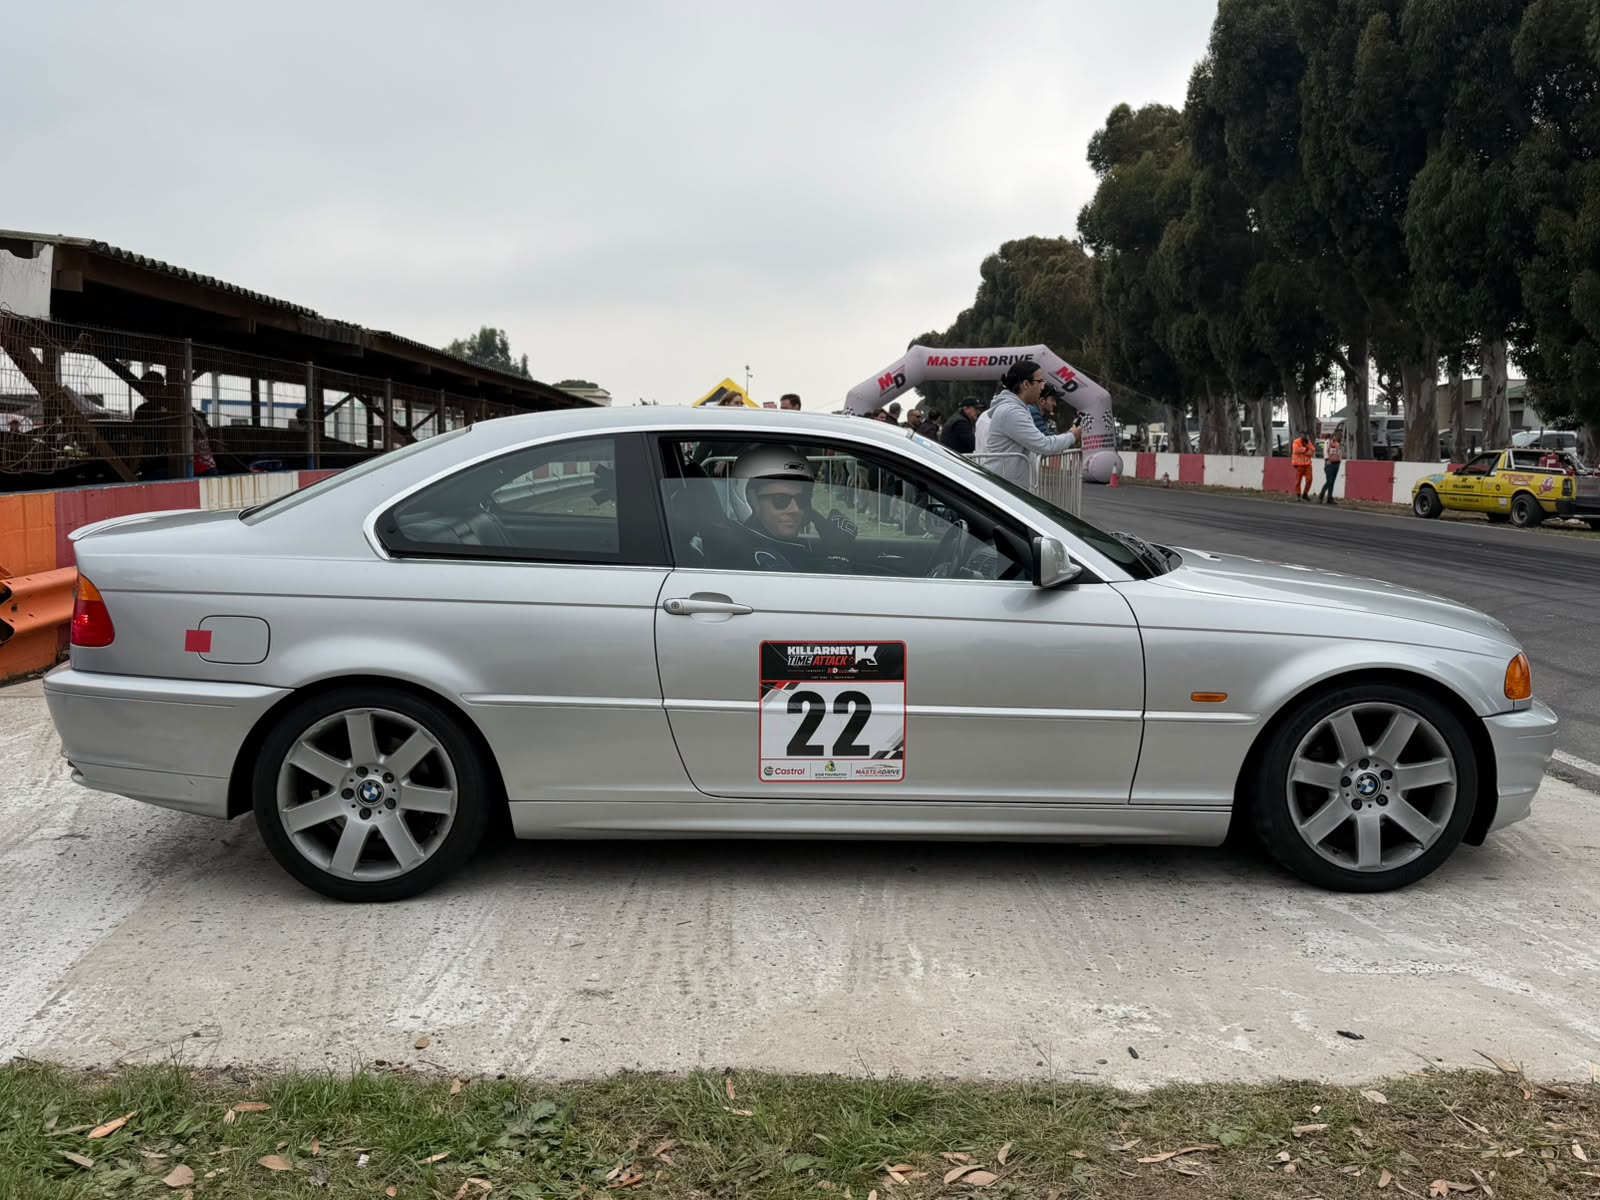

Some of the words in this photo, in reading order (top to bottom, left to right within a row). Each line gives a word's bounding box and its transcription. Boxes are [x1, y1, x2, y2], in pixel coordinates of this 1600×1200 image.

[927, 354, 1034, 367] MASTERDRIVE
[787, 646, 855, 655] KILLARNEY
[787, 655, 814, 666] TIME
[813, 655, 848, 666] ATTACK
[786, 690, 872, 756] 22
[774, 768, 805, 776] Castrol
